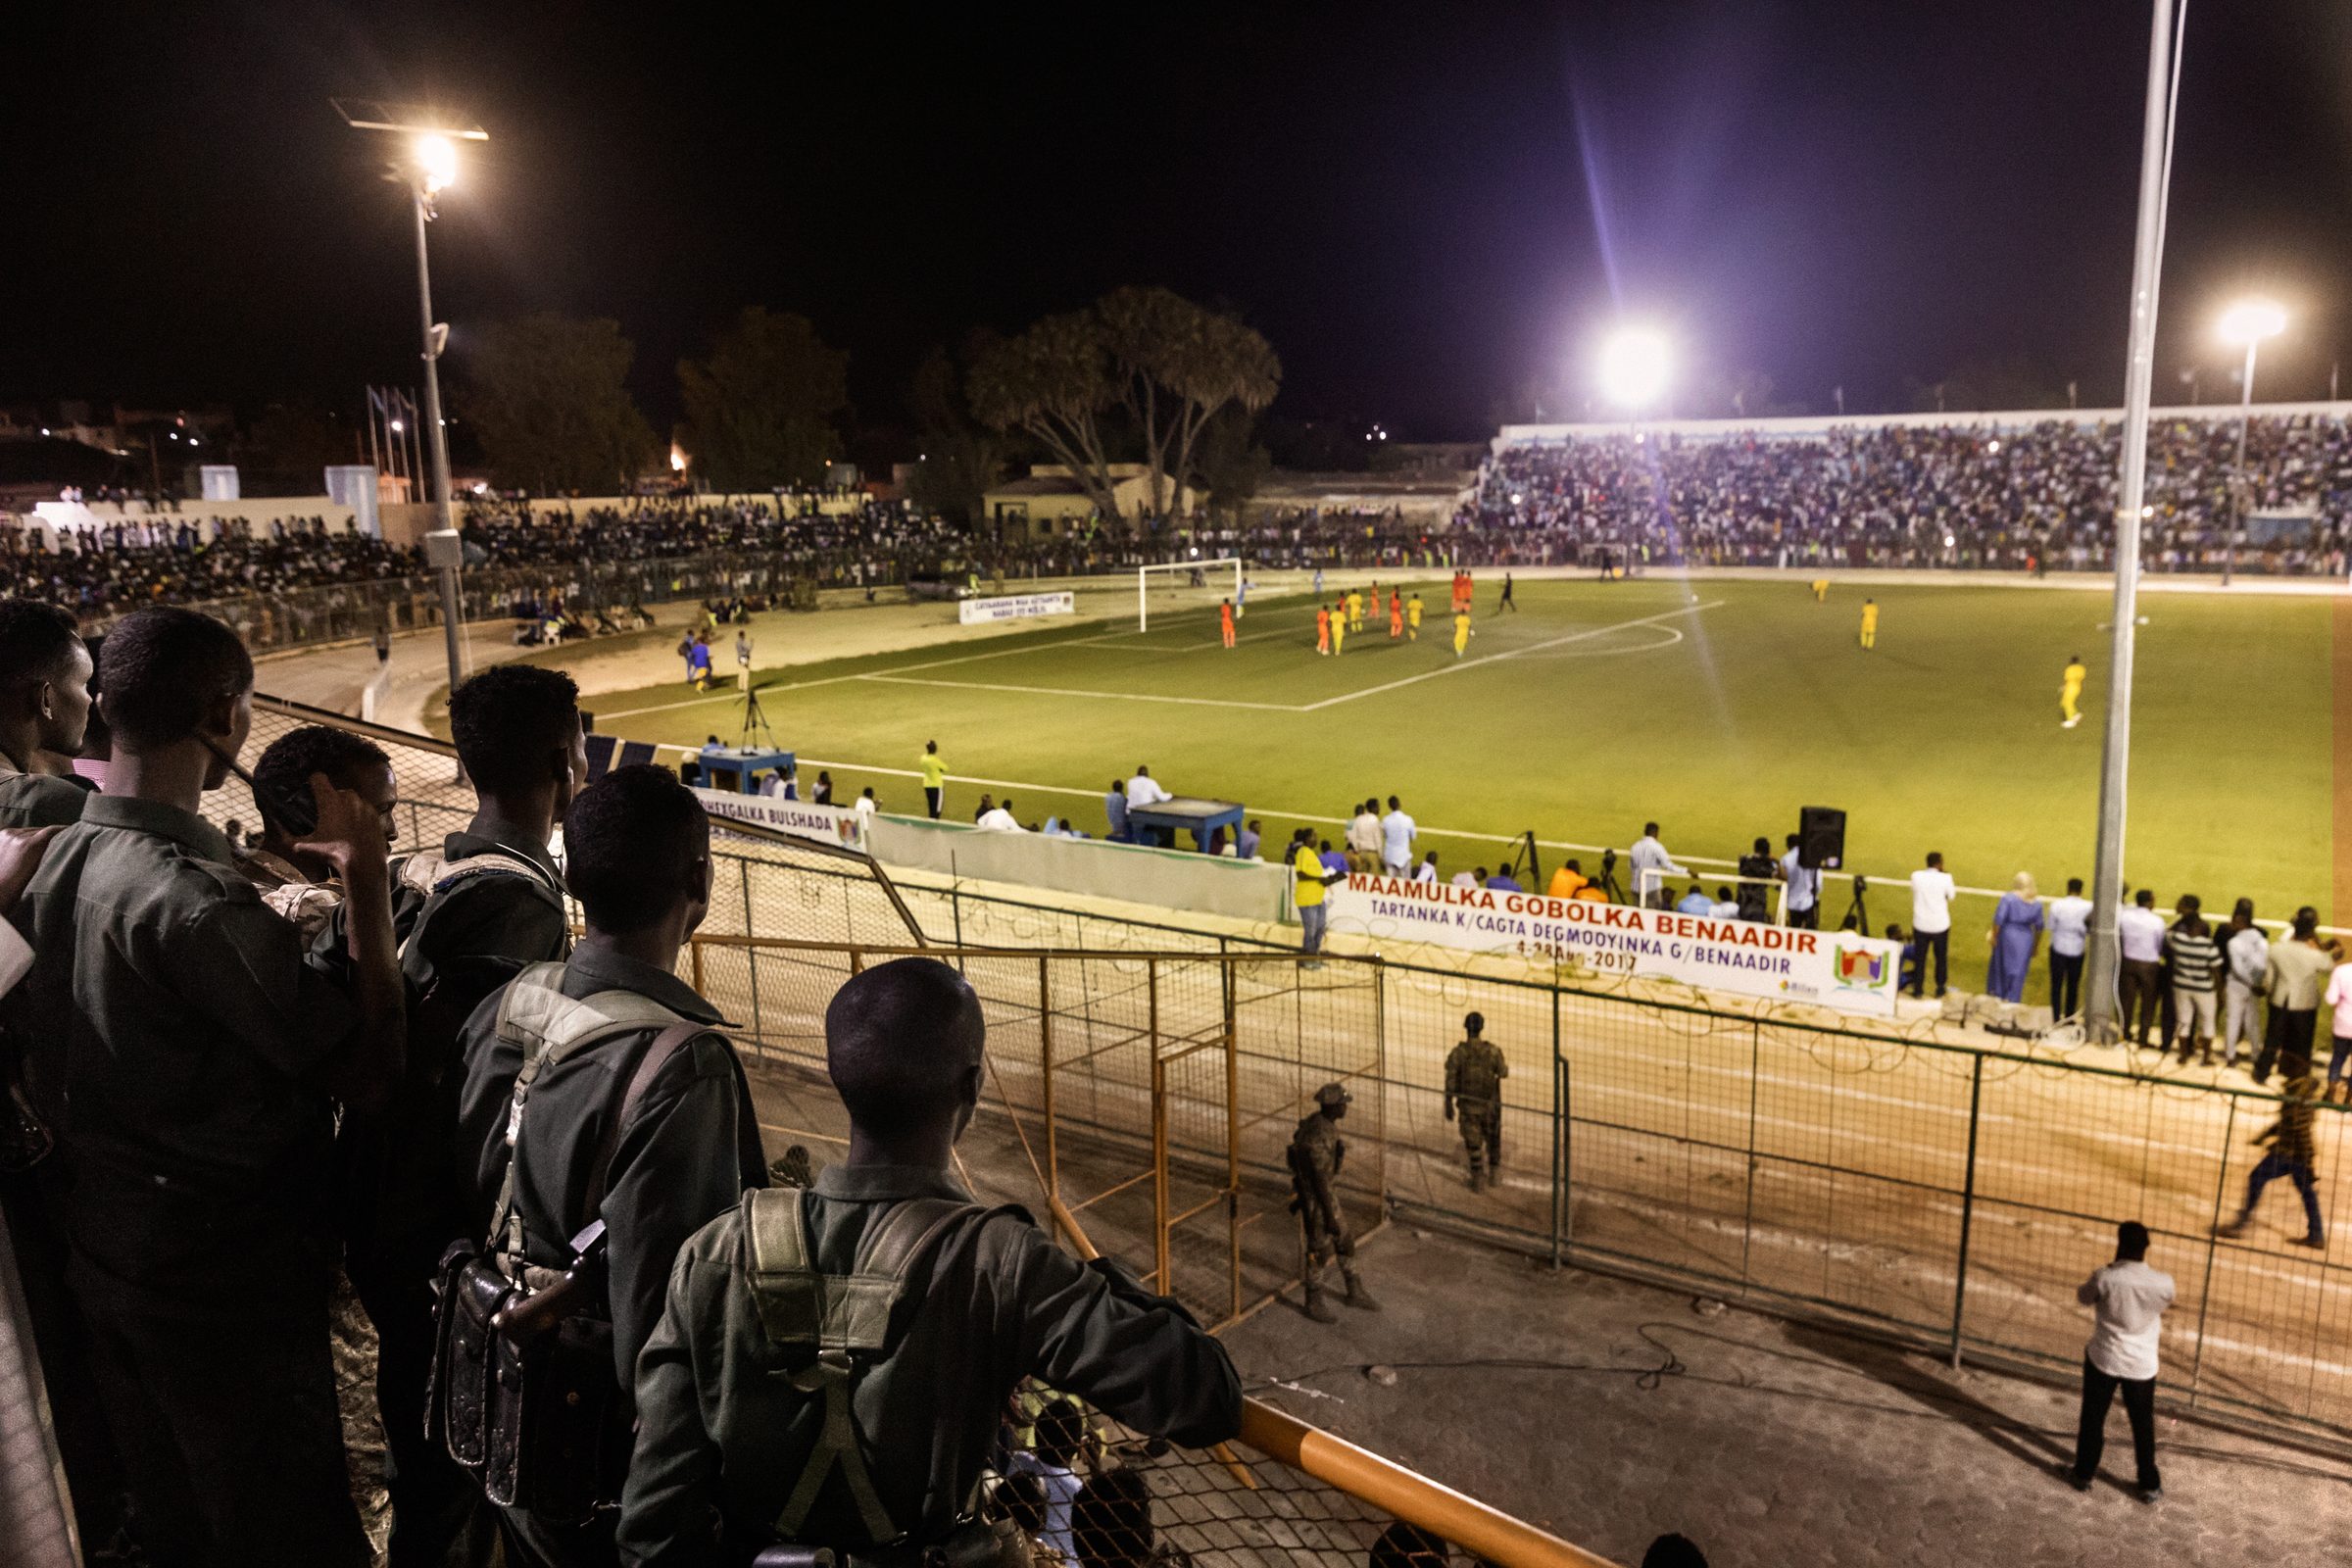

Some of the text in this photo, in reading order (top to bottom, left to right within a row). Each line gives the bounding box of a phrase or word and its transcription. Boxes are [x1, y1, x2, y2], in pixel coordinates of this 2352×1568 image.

[769, 809, 832, 831] BULSHADA
[1348, 873, 1817, 955] MAAMULKA GOBOLKA BENAADIR
[1371, 900, 1448, 924] TARTANKA
[1456, 912, 1526, 936] K/CAGTA
[1671, 940, 1791, 975] G/BENAADIR
